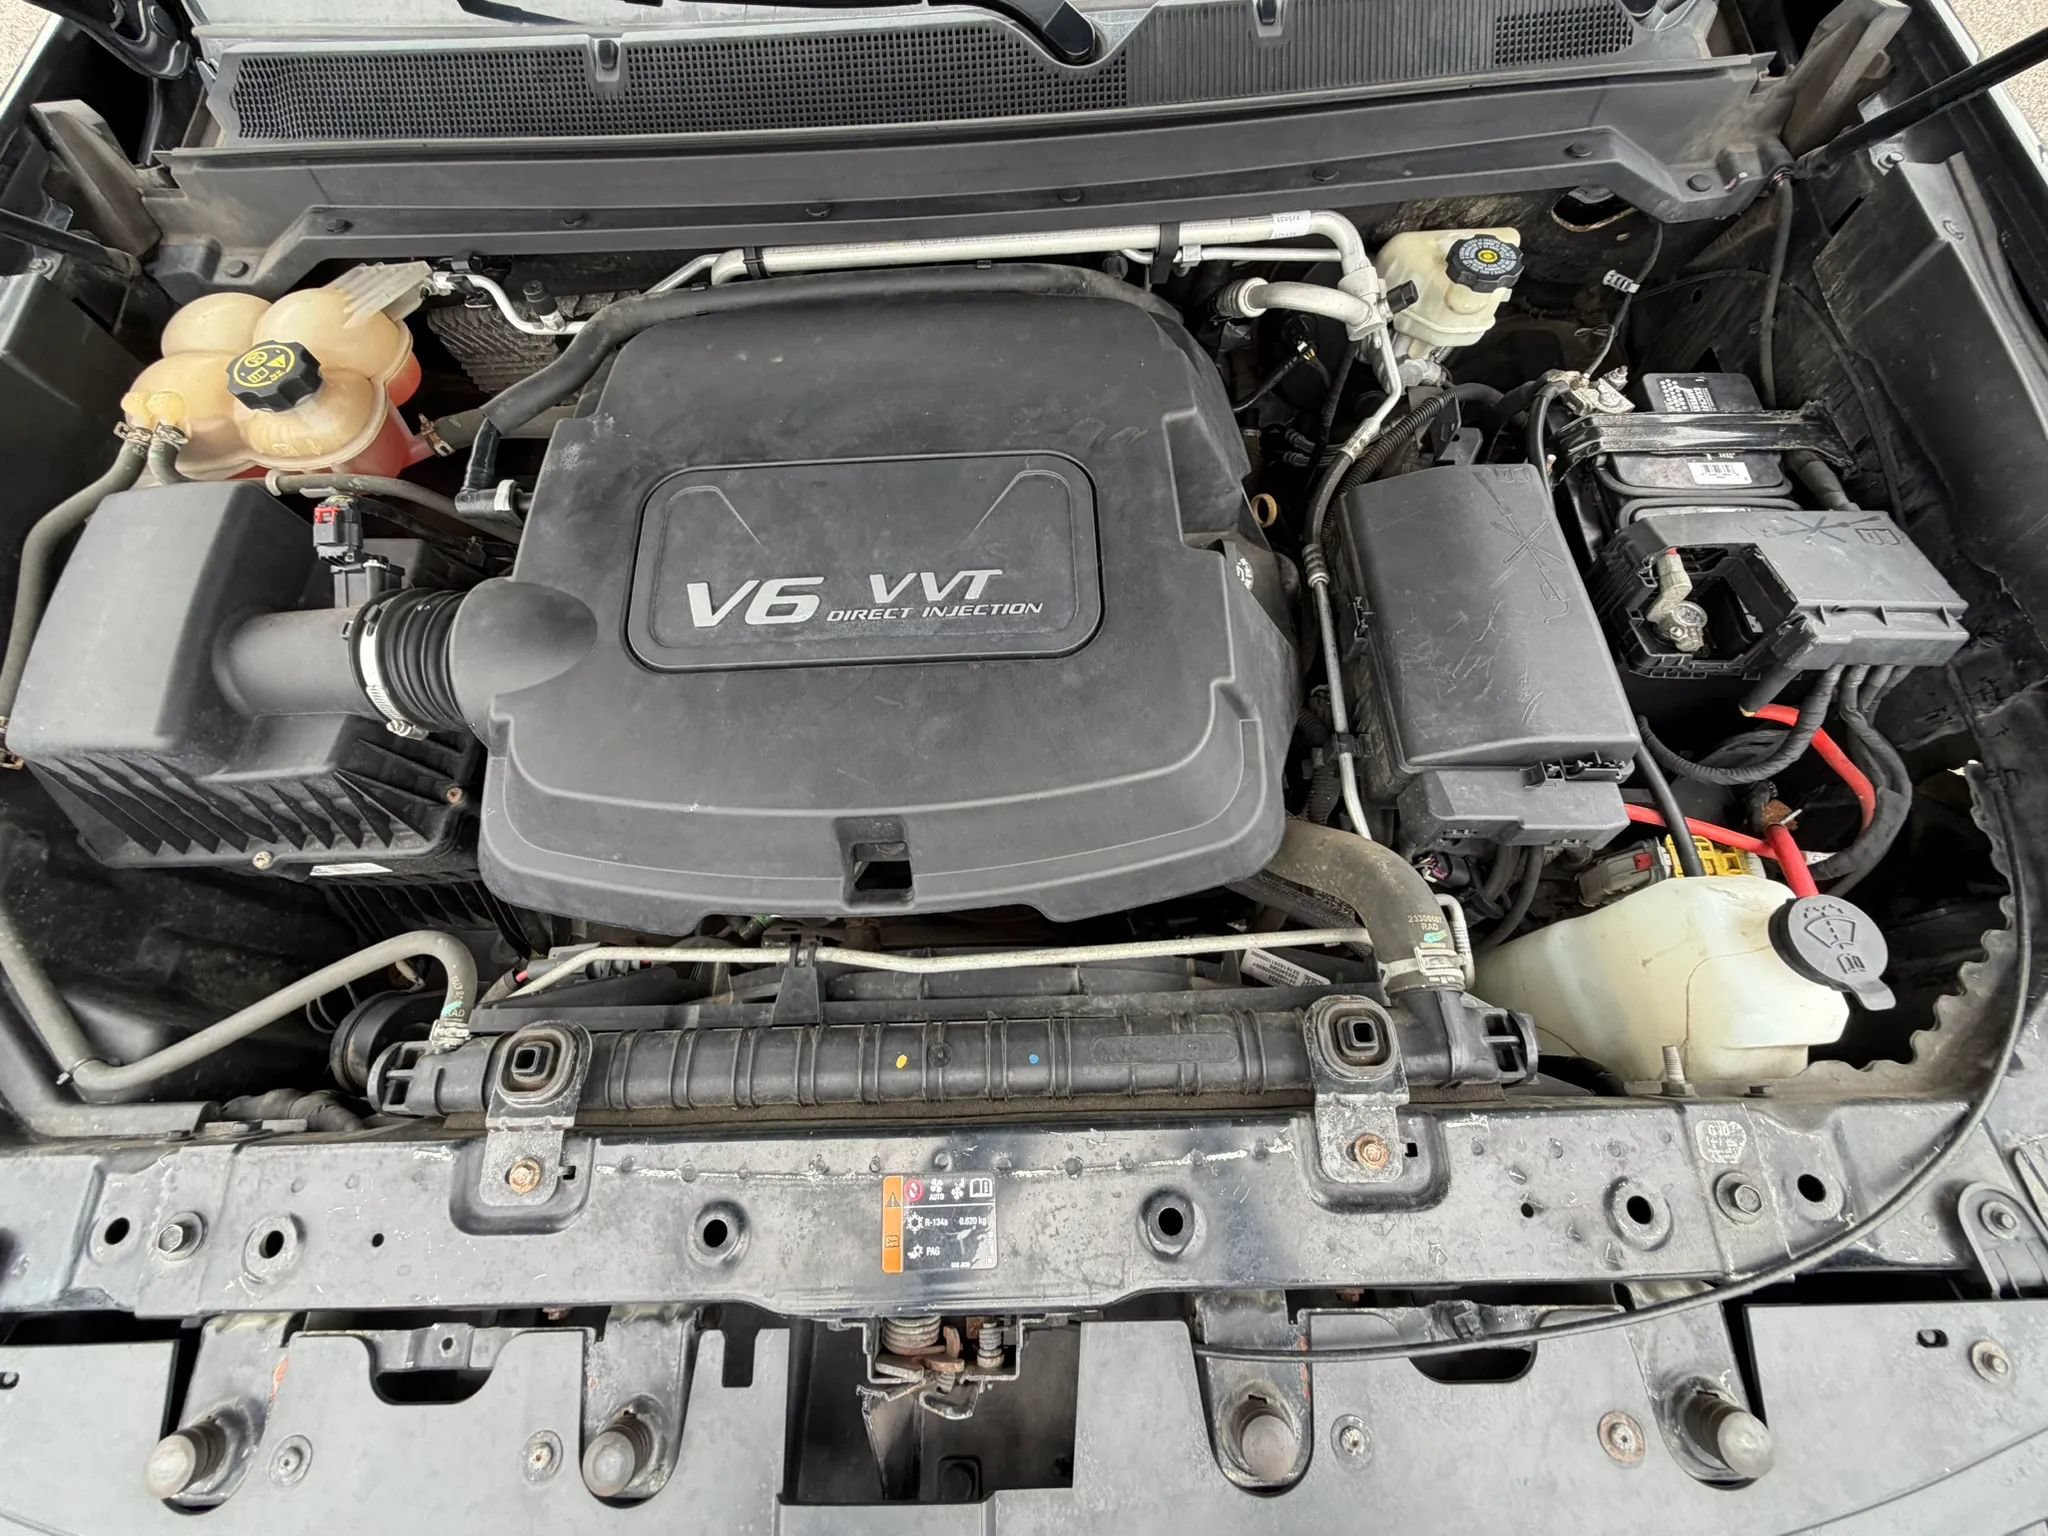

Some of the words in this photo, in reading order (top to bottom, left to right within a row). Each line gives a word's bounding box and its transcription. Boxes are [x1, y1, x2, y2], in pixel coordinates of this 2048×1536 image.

[869, 569, 1003, 603] VVT
[687, 576, 825, 628] V6
[826, 607, 914, 622] DIRECT
[921, 602, 1044, 619] INJECTION
[1420, 922, 1439, 931] RAD
[929, 1193, 945, 1201] AUTO
[924, 1218, 949, 1227] R-134a
[959, 1216, 978, 1226] 0.620
[978, 1216, 987, 1227] kg
[926, 1246, 940, 1256] PAG
